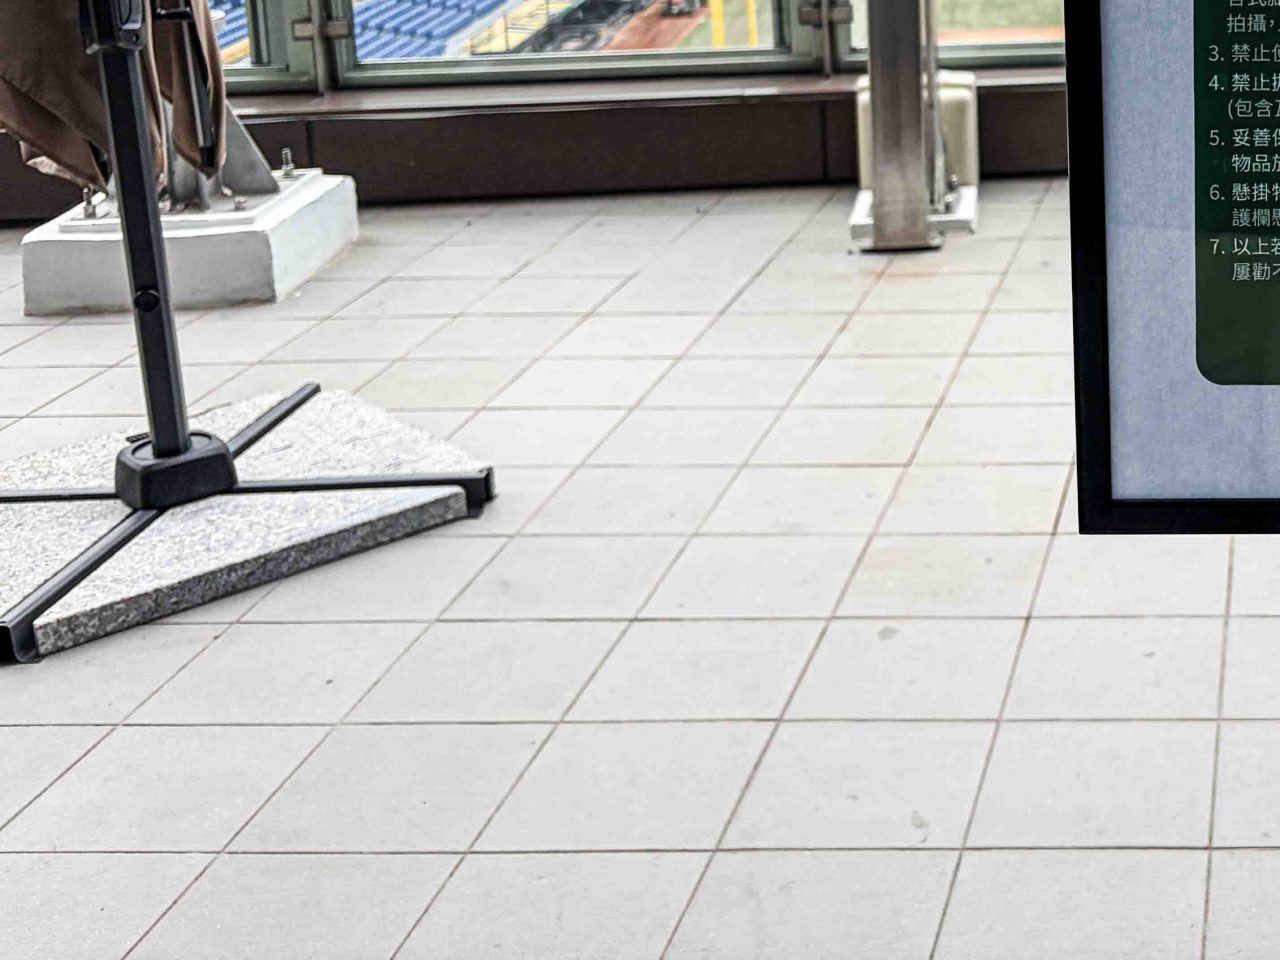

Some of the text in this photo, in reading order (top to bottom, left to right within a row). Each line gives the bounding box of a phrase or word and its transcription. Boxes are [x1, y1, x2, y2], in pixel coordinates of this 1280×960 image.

[1208, 45, 1224, 62] 3.
[1208, 74, 1225, 91] 4.
[1209, 129, 1225, 146] 5.
[1209, 184, 1225, 201] 6.
[1209, 238, 1226, 255] 7.
